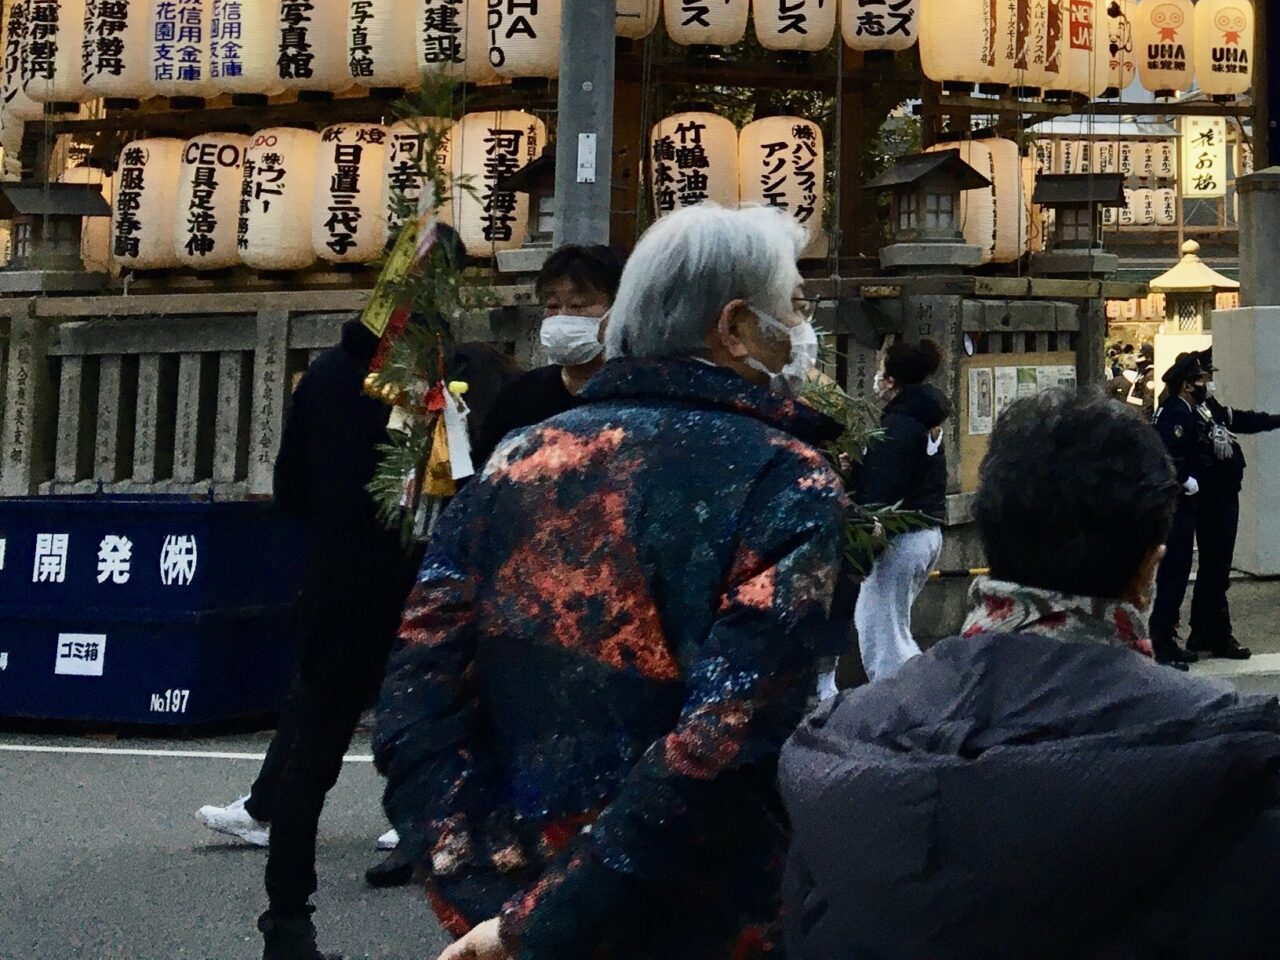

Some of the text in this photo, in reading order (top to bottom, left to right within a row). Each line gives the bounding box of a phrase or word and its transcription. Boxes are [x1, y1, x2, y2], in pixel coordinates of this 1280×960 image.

[154, 2, 177, 82] 花園支店
[1147, 43, 1185, 60] UHA
[1212, 47, 1248, 64] UHA
[60, 641, 99, 662] ゴミ箱
